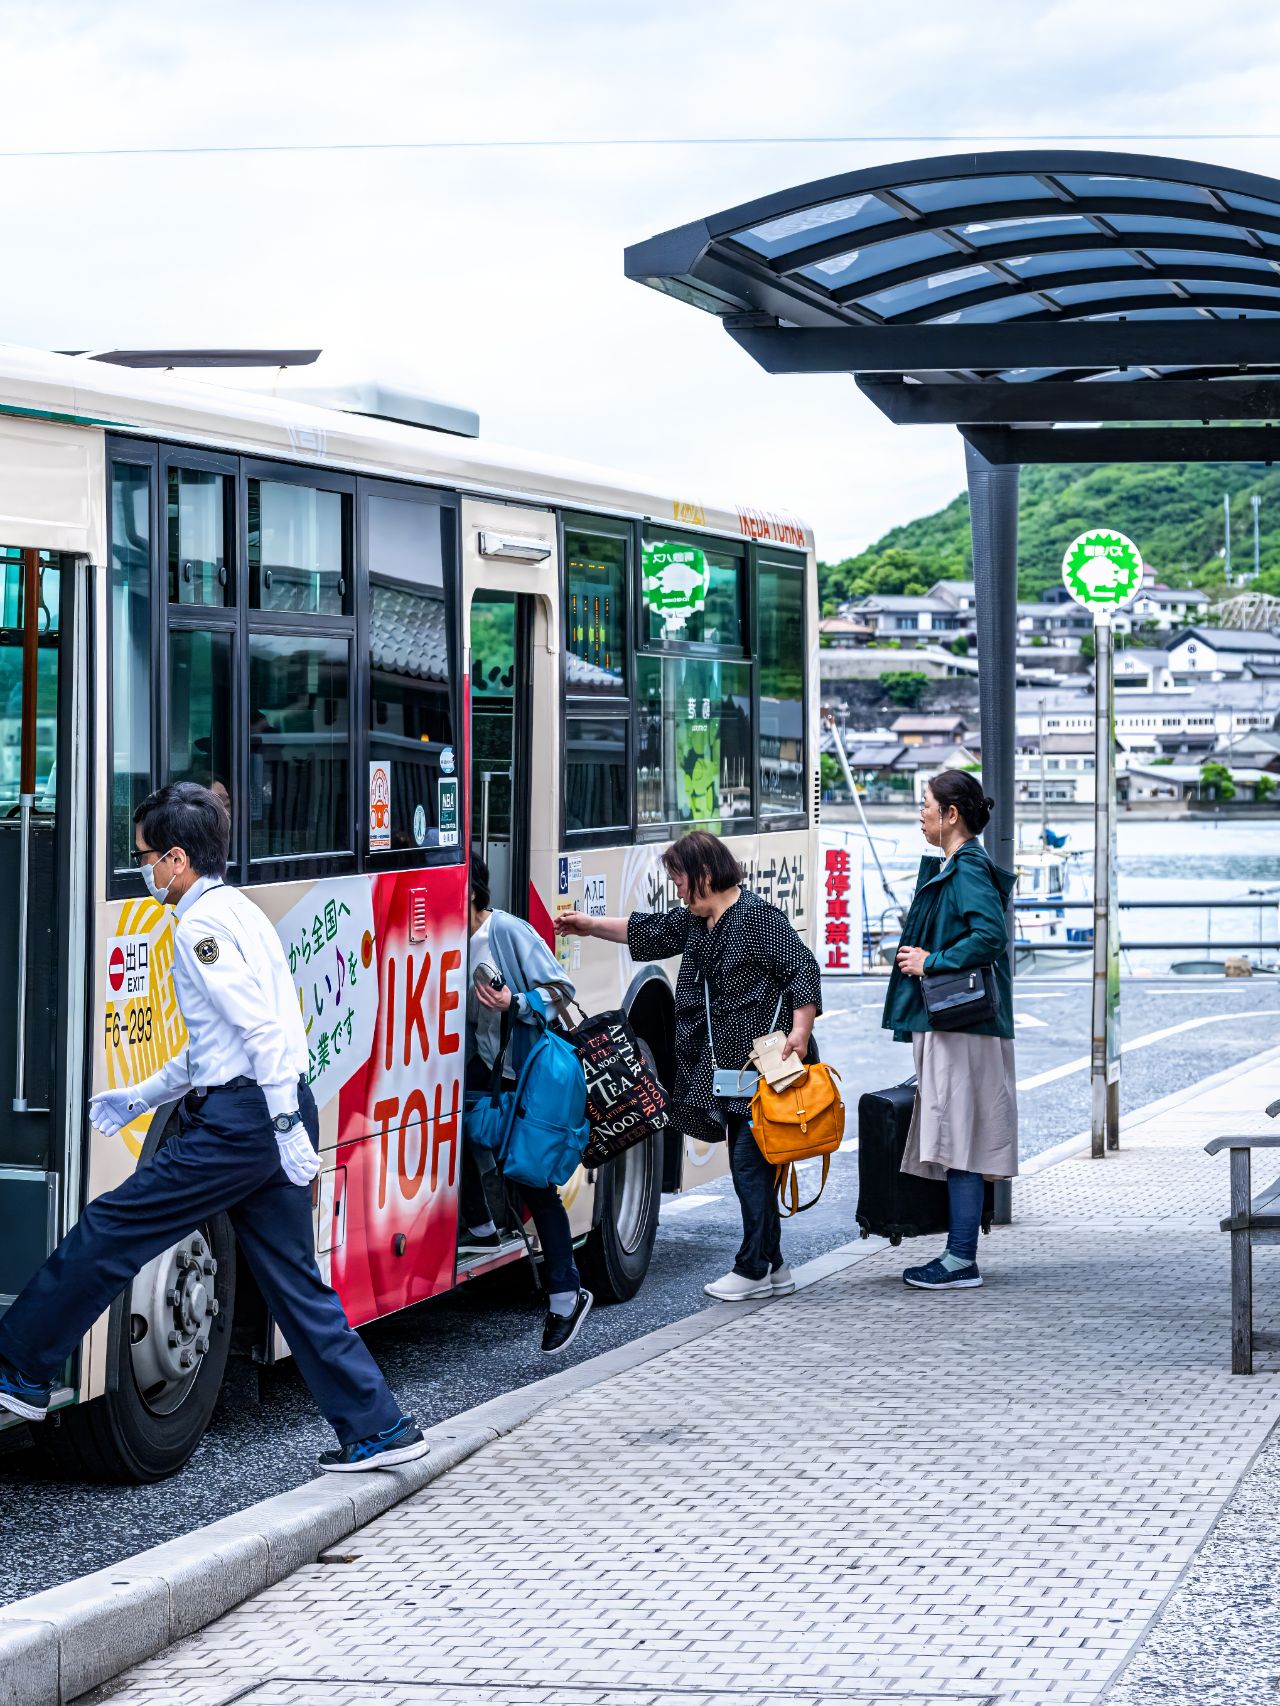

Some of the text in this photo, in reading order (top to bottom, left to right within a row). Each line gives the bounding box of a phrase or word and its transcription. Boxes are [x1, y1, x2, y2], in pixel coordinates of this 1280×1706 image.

[592, 880, 604, 901] 入口
[125, 942, 148, 971] 出口
[127, 975, 145, 993] EXIT
[104, 1007, 152, 1050] F6-293
[385, 950, 461, 1071] IKE
[608, 1024, 641, 1078] AFTER
[586, 1073, 634, 1108] TEA
[374, 1079, 459, 1210] TOH
